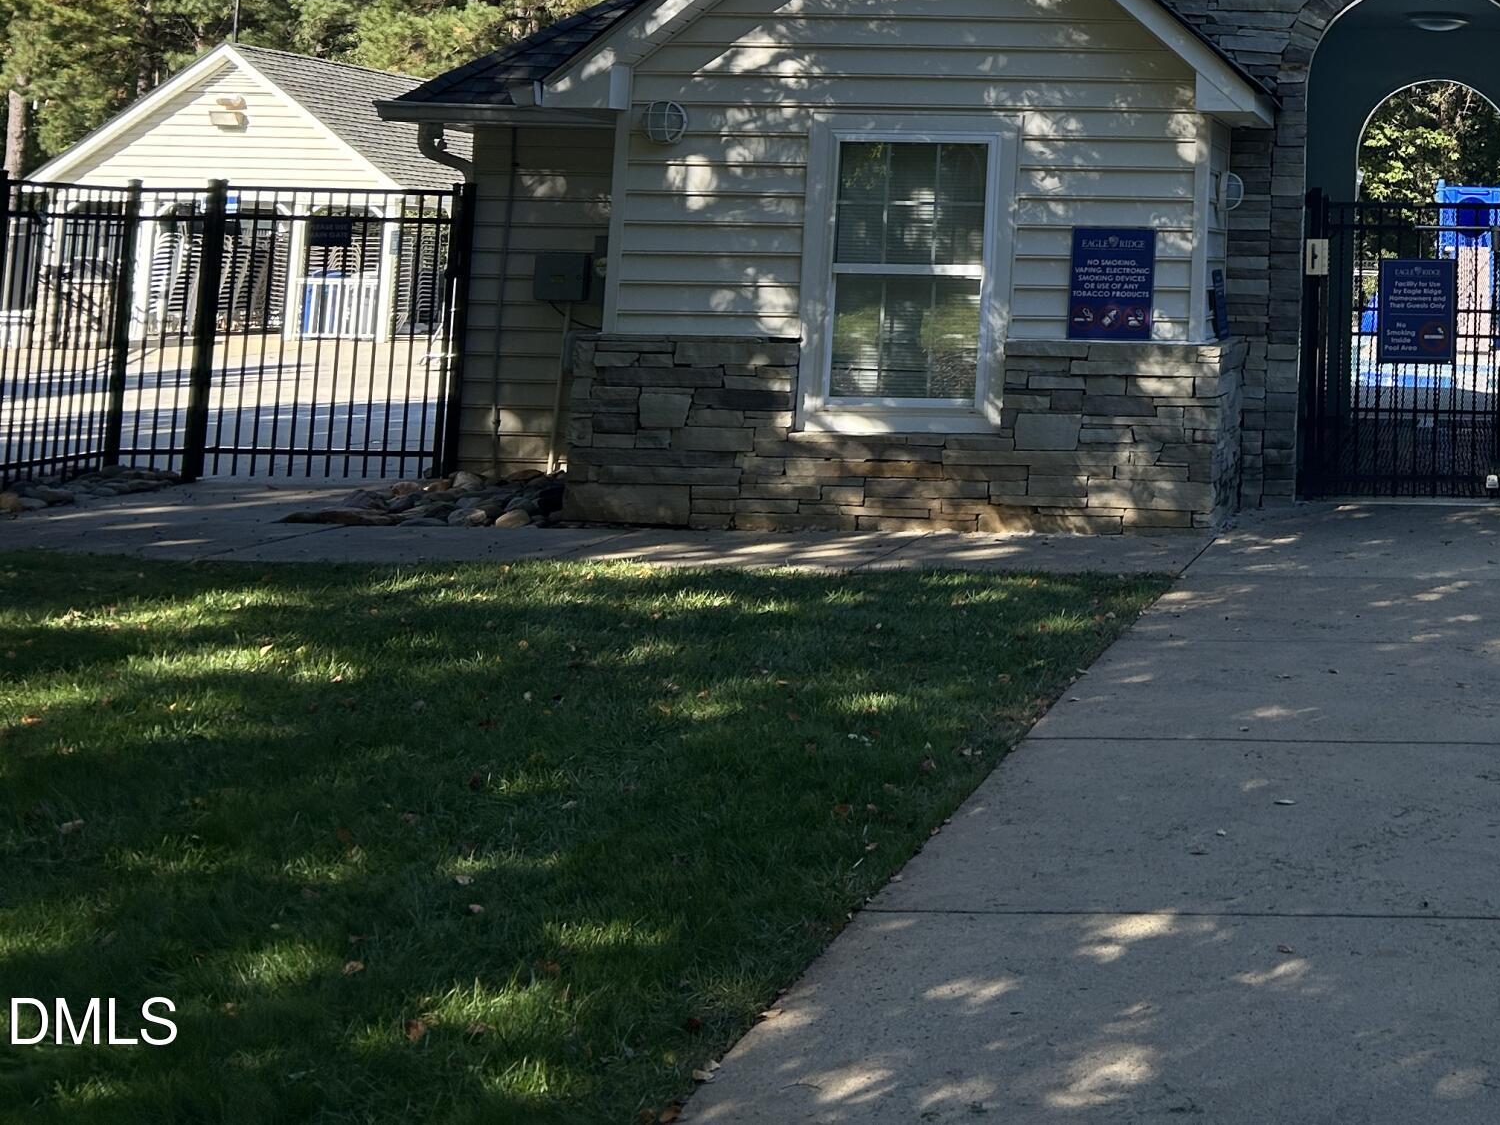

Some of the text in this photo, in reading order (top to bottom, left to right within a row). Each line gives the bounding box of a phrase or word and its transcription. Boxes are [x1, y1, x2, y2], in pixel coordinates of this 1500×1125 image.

[1081, 239, 1145, 248] EAGLE RIDGE
[1386, 329, 1416, 337] Smoking
